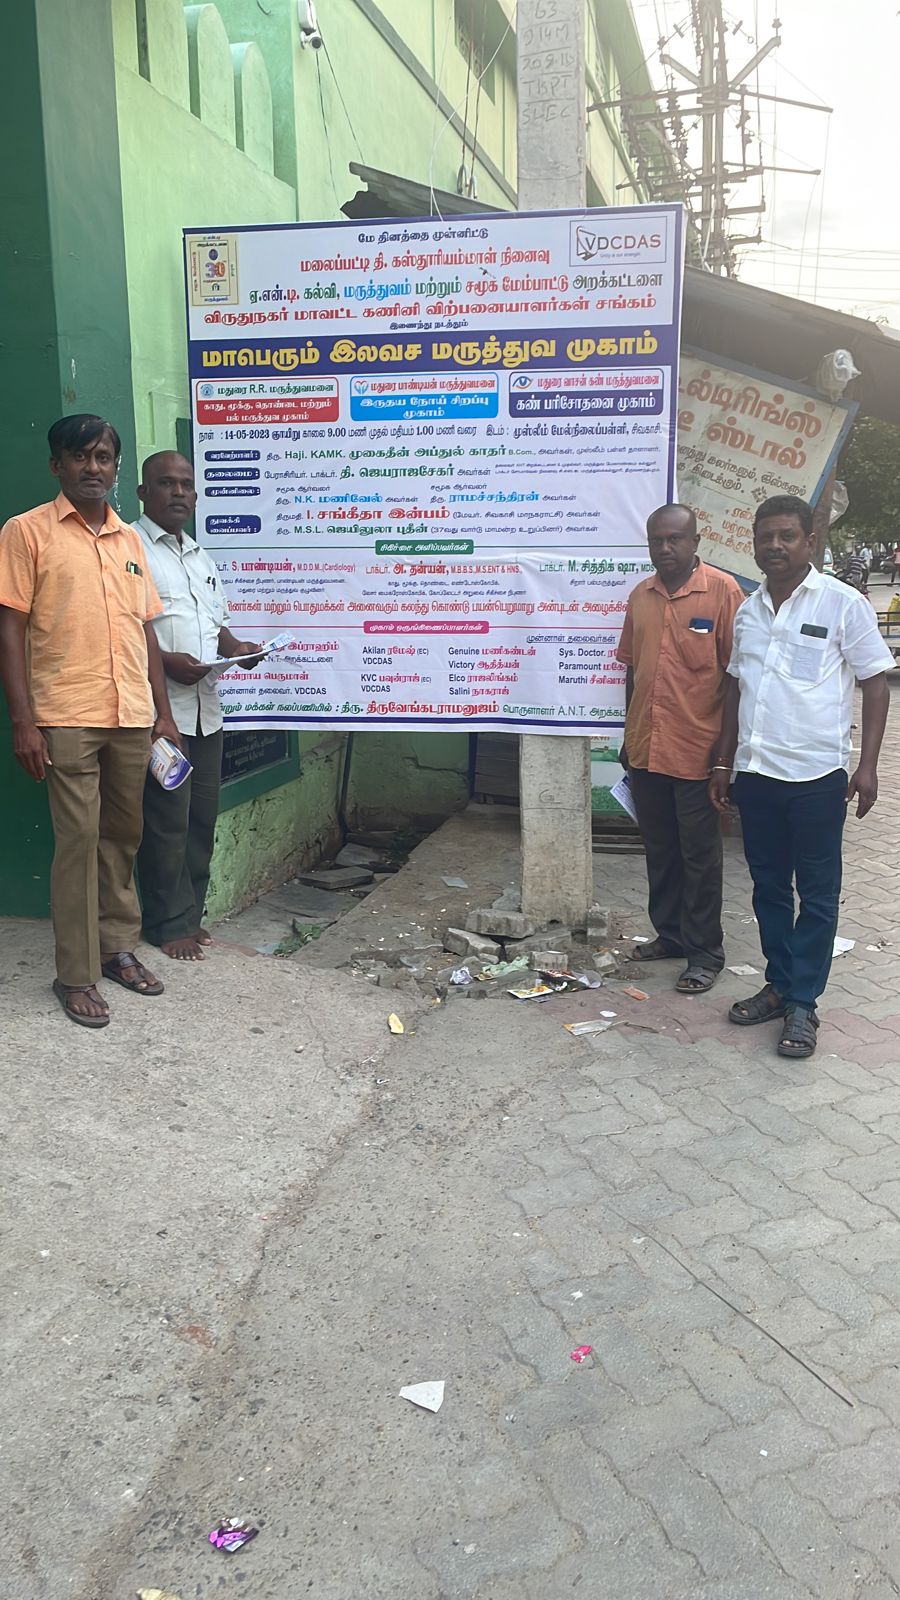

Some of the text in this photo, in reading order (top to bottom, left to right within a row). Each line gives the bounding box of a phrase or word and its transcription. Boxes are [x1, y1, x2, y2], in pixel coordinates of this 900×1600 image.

[358, 227, 489, 244] மே தினத்தை முன்னிட்டு
[585, 234, 661, 250] VDCDAS
[300, 247, 550, 272] மலைப்பட்டி தி. கஸ்தூரியம்மாள் நினைவு
[250, 270, 663, 305] ஏ.என்.டி. கல்வி, மருத்துவம் மற்றும் சமூக மேம்பாட்டு அறக்கட்டளை
[204, 293, 657, 326] விருதுநகர் மாவட்ட கணினி விற்பனையாளர்கள் சங்கம்
[202, 330, 658, 371] மாபெரும் இலவச மருத்துவ முகாம்
[371, 376, 495, 392] மதுரை பாண்டியன் மருத்துவமனை
[538, 373, 659, 389] மதுரை மருத்துவமனை
[217, 382, 334, 396] மதுரை R.R. மருத்துவமனை
[255, 398, 332, 410] தொண்டை மற்றும்
[360, 393, 488, 408] இருதய நோய் சிறப்பு
[516, 391, 656, 412] கண் பரிசோதனை முகாம்
[678, 369, 822, 438] ல்டிரிங்ஸ்
[226, 411, 309, 423] பல் மருத்துவ முகாம்
[403, 407, 445, 419] முகாம்
[199, 429, 214, 443] நாள்
[271, 428, 300, 441] ஞாயிறு
[302, 428, 326, 438] காலை
[327, 428, 346, 438] 9.00
[348, 426, 367, 438] மணி
[369, 426, 389, 440] முதல்
[390, 425, 414, 439] மதியம்
[416, 425, 433, 436] 1.00
[436, 424, 456, 435] மணி
[457, 425, 477, 437] வரை
[513, 423, 549, 439] முஸ்லீம்
[706, 416, 807, 469] ஸ்டால்
[285, 451, 308, 461] Haji.
[310, 450, 346, 459] KAMK.
[348, 447, 410, 460] முகைதீன்
[414, 445, 465, 459] அப்துல்
[468, 444, 506, 457] காதர்
[206, 463, 491, 480] தலைமை தி. ஜெயராஜசேகர் அவர்கள்
[295, 493, 418, 504] N.K. மணிவேல் அவர்கள்
[449, 491, 541, 503] ராமச்சந்திரன்
[317, 507, 383, 521] சங்கீதா
[388, 505, 450, 520] இன்பம்
[484, 510, 515, 519] சிவகாசி
[565, 510, 601, 518] அவர்கள்
[294, 525, 324, 534] M.S.L.
[397, 524, 428, 535] புதீன்
[460, 524, 483, 533] வார்டு
[565, 524, 598, 533] அவர்கள்
[241, 558, 295, 573] பாண்டியன்,
[568, 560, 578, 572] M.
[581, 558, 615, 574] சித்திக்
[264, 599, 291, 614] மற்றும்
[293, 599, 345, 615] பொதுமக்கள்
[347, 600, 398, 615] அனைவரும்
[401, 599, 429, 615] கலந்து
[431, 599, 469, 613] கொண்டு
[472, 599, 534, 615] பயன்பெறுமாறு
[538, 599, 580, 614] அன்புடன்
[288, 641, 339, 652] இப்ராஹிம்
[363, 646, 386, 655] Akilan
[387, 645, 415, 656] ரமேஷ்
[448, 646, 536, 656] Genuine மணிகண்டன்
[559, 648, 576, 658] Sys.
[578, 648, 606, 657] Doctor.
[363, 657, 392, 665] VDCDAS
[448, 660, 475, 670] Victory
[558, 662, 601, 671] Paramount
[264, 671, 309, 682] பெருமாள்
[361, 673, 377, 682] KVC
[449, 673, 518, 683] Elco ராஜலிங்கம்
[558, 675, 588, 684] Maruthi
[295, 687, 327, 695] VDCDAS
[361, 685, 391, 693] VDCDAS
[449, 686, 510, 697] Salini நாகராஜ்
[220, 702, 242, 714] ன்றும்
[244, 701, 275, 711] மக்கள்
[277, 701, 333, 712] நலப்பணியில்
[341, 702, 363, 714] திரு.
[503, 704, 555, 717] பொருளாளர்
[558, 705, 586, 717] A.N.T.
